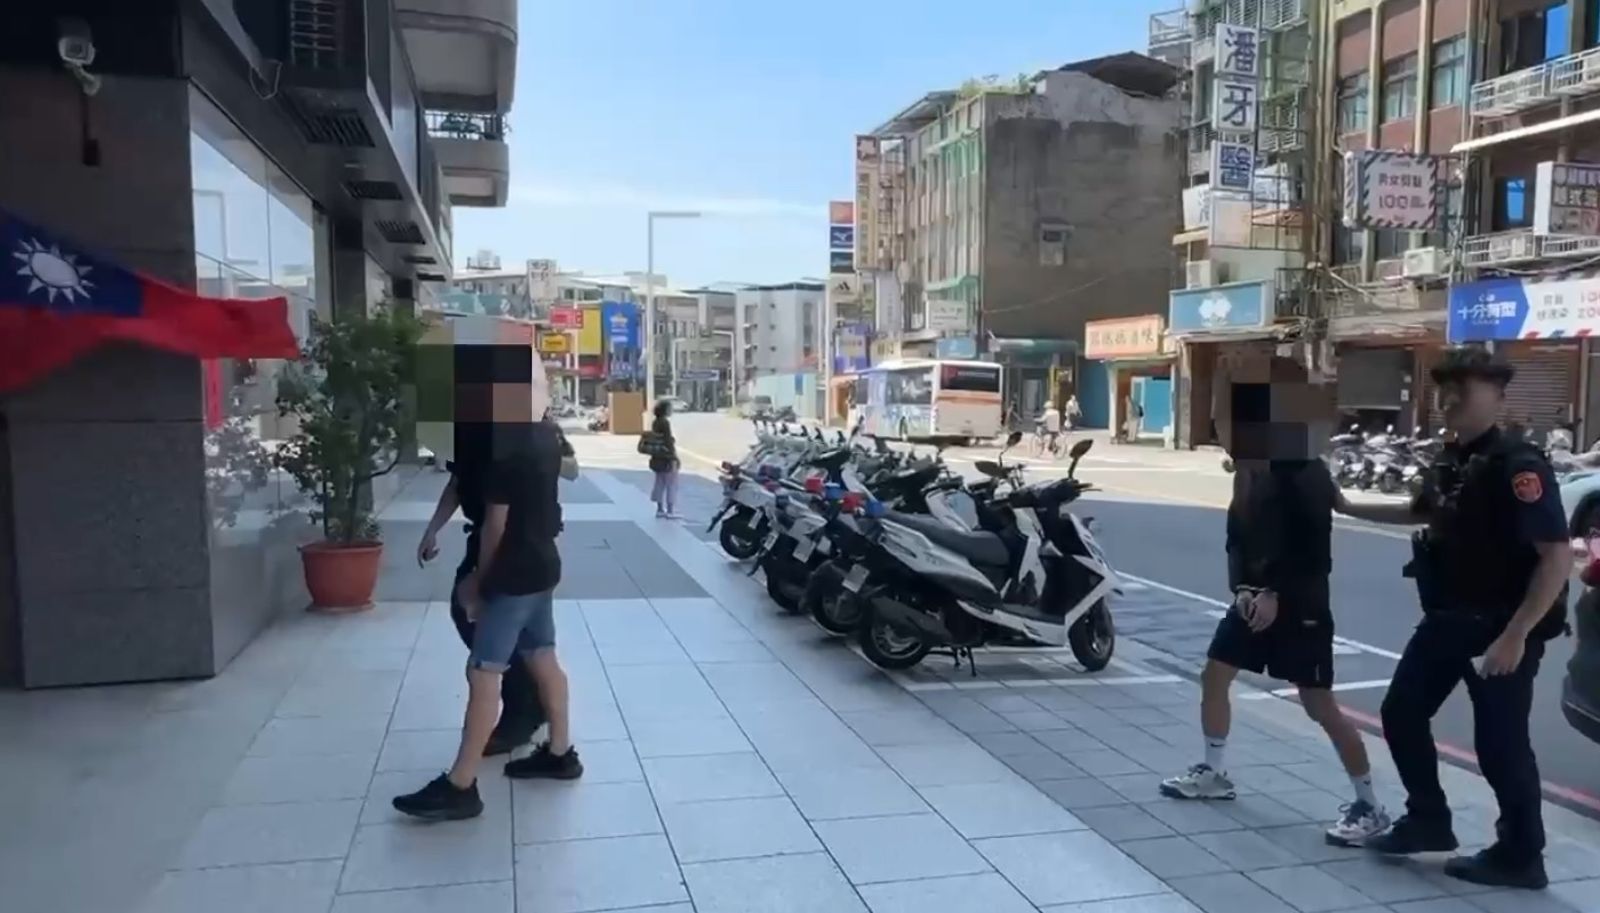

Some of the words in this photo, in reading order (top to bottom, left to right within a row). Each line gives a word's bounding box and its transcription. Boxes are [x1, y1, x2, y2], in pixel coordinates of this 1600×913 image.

[1220, 26, 1256, 188] 潘牙醫
[1379, 194, 1409, 209] 100
[1581, 291, 1600, 302] 10
[1577, 307, 1600, 319] 20
